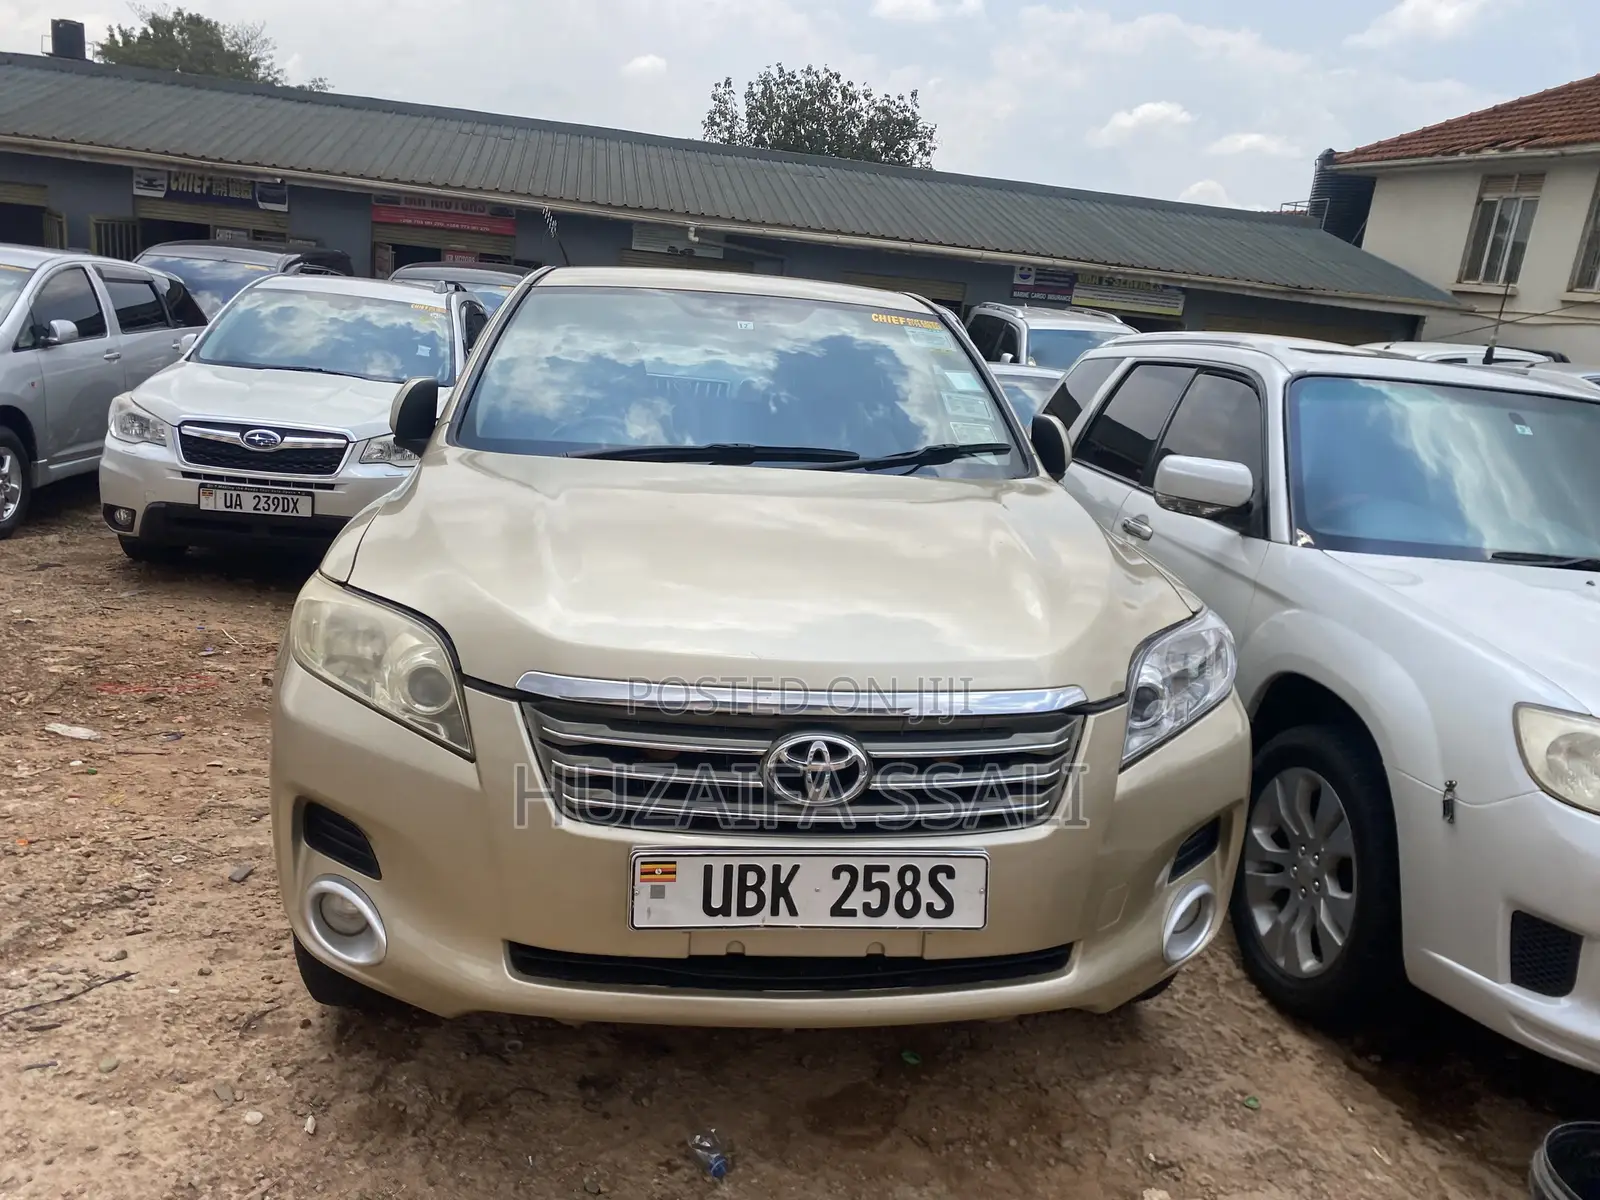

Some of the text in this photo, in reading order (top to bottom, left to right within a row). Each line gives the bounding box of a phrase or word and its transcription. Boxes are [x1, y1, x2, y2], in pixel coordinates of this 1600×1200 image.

[170, 171, 210, 194] CHIEF
[1013, 290, 1029, 298] MARINE
[1047, 294, 1072, 302] INSURANCE
[871, 313, 906, 325] CHIEF
[224, 492, 300, 514] UA 239DX
[702, 863, 956, 919] UBK 258S
